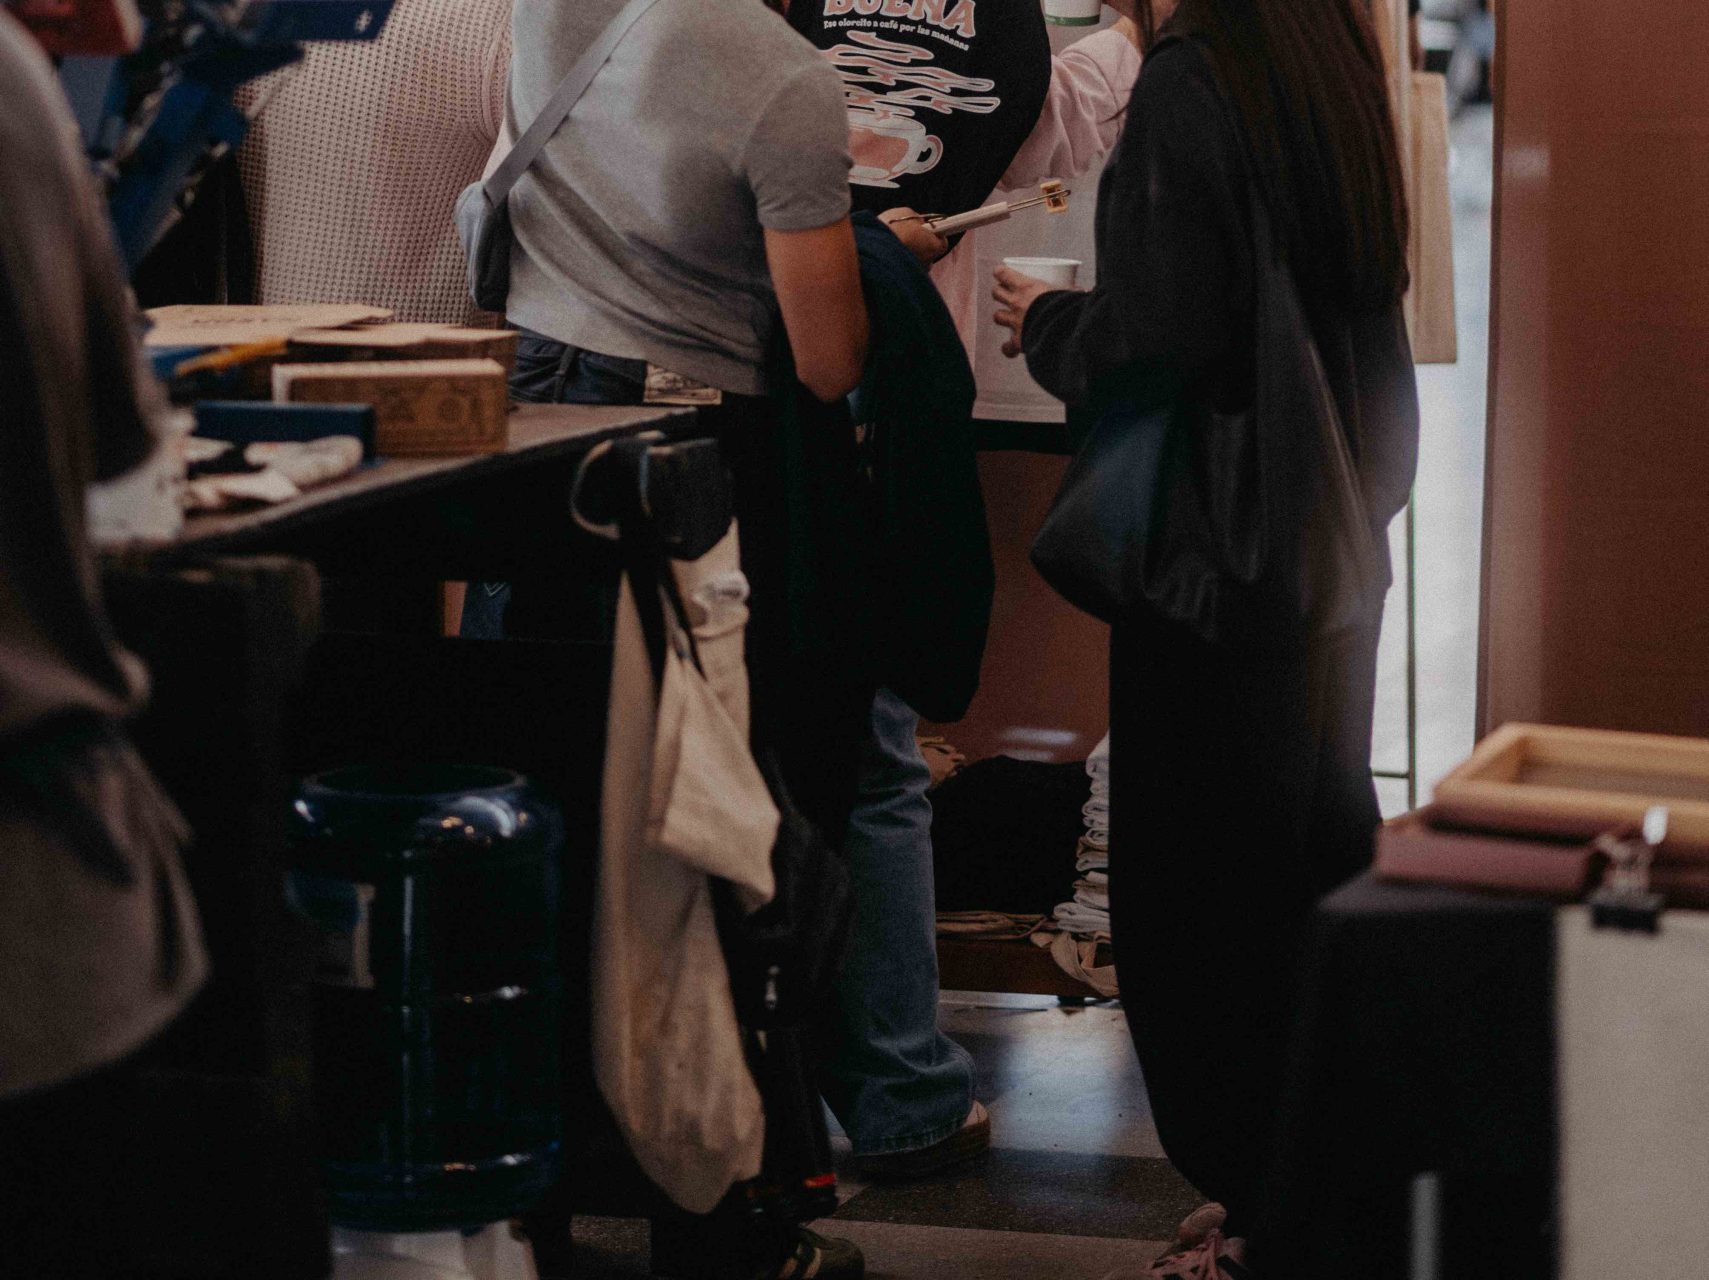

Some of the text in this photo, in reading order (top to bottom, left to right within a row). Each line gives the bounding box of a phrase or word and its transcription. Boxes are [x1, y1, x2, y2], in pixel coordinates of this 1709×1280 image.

[838, 18, 872, 28] olorcito
[879, 20, 899, 30] café
[899, 24, 916, 32] por
[917, 25, 931, 35] las
